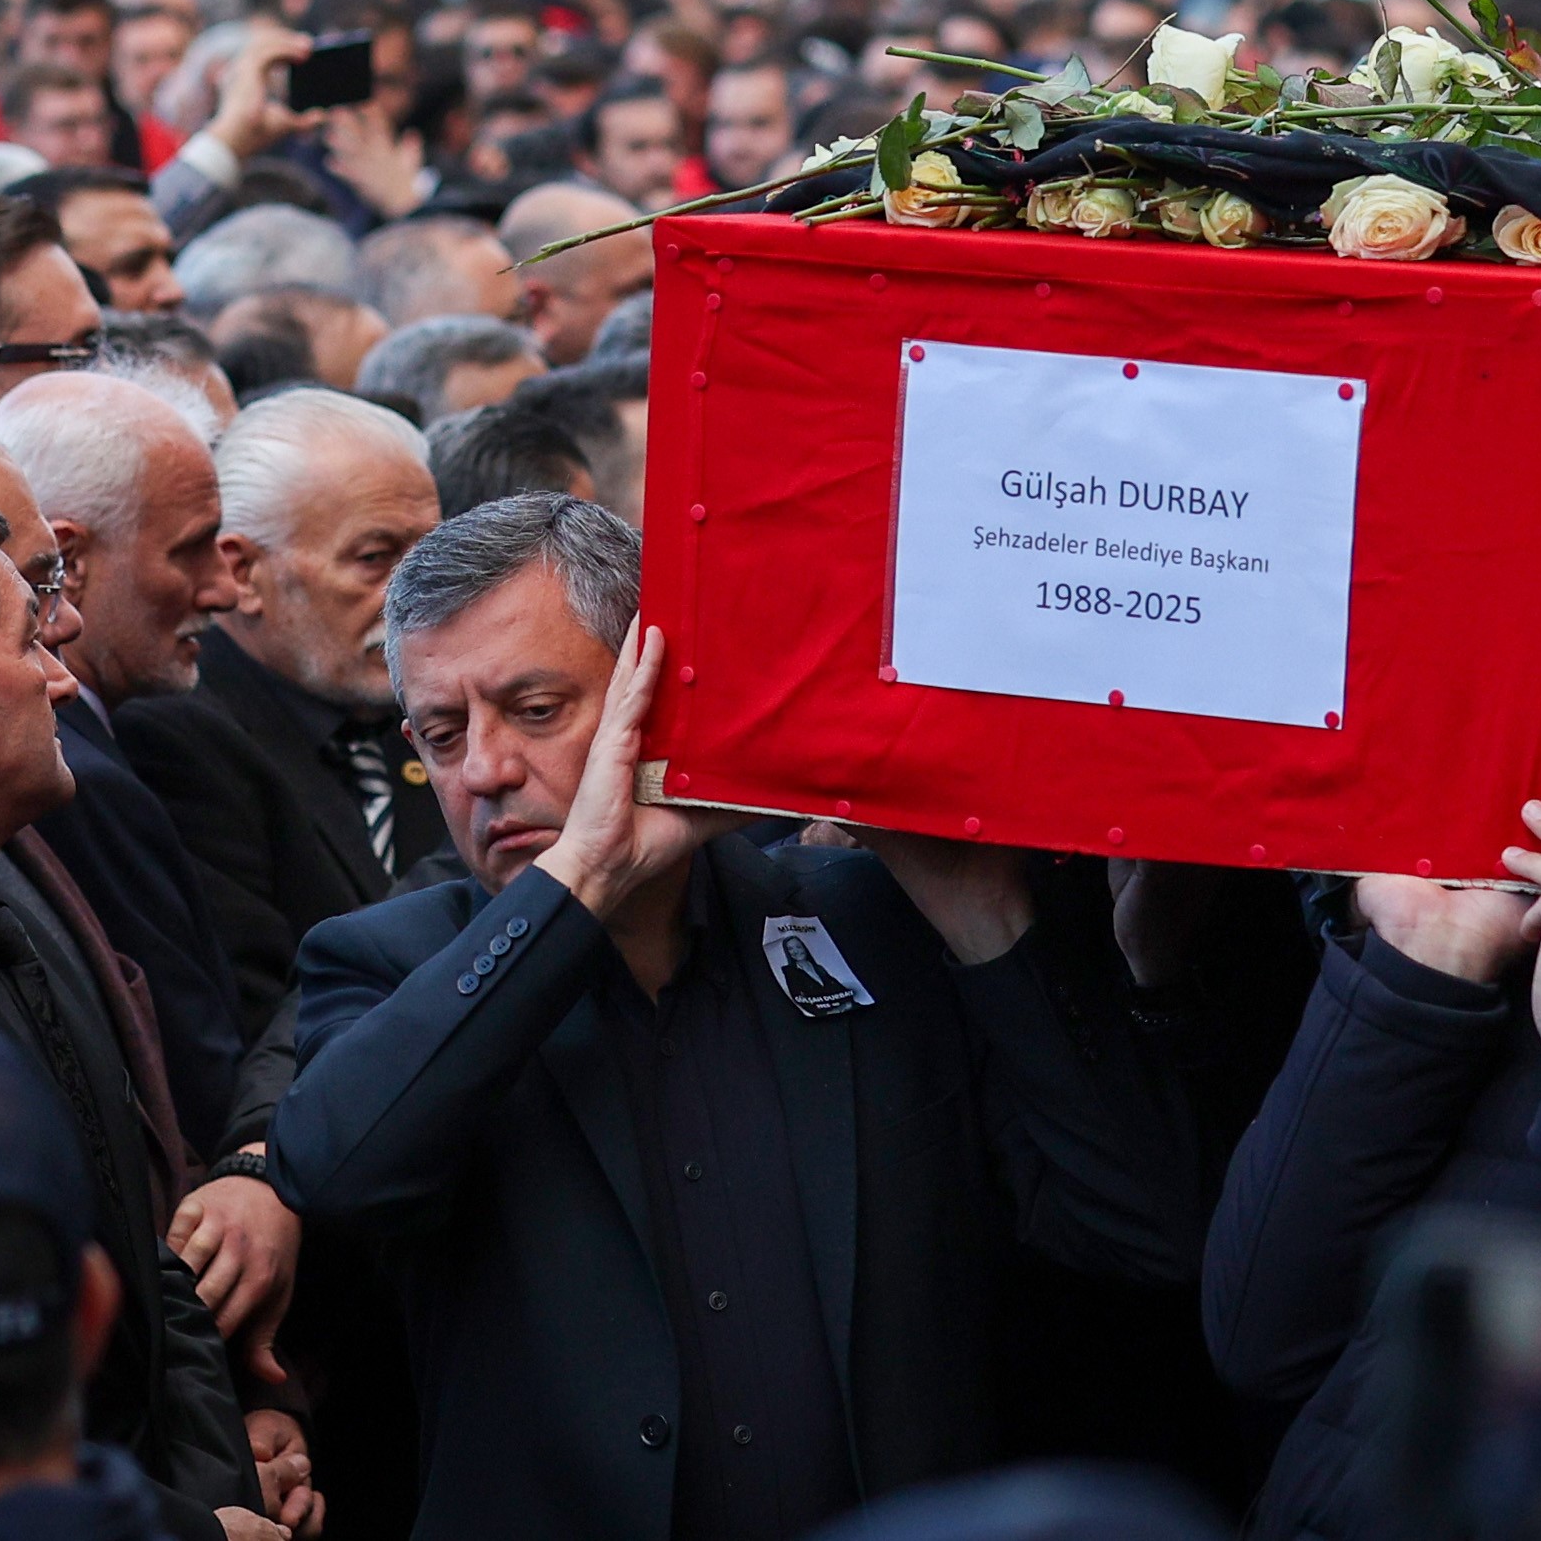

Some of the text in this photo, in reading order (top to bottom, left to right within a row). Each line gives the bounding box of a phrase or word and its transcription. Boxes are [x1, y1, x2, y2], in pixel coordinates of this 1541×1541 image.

[1001, 469, 1249, 519] Gülşah DURBAY
[973, 525, 1270, 574] Şehzadeler Belediye Başkanı
[1036, 581, 1202, 624] 1988-2025
